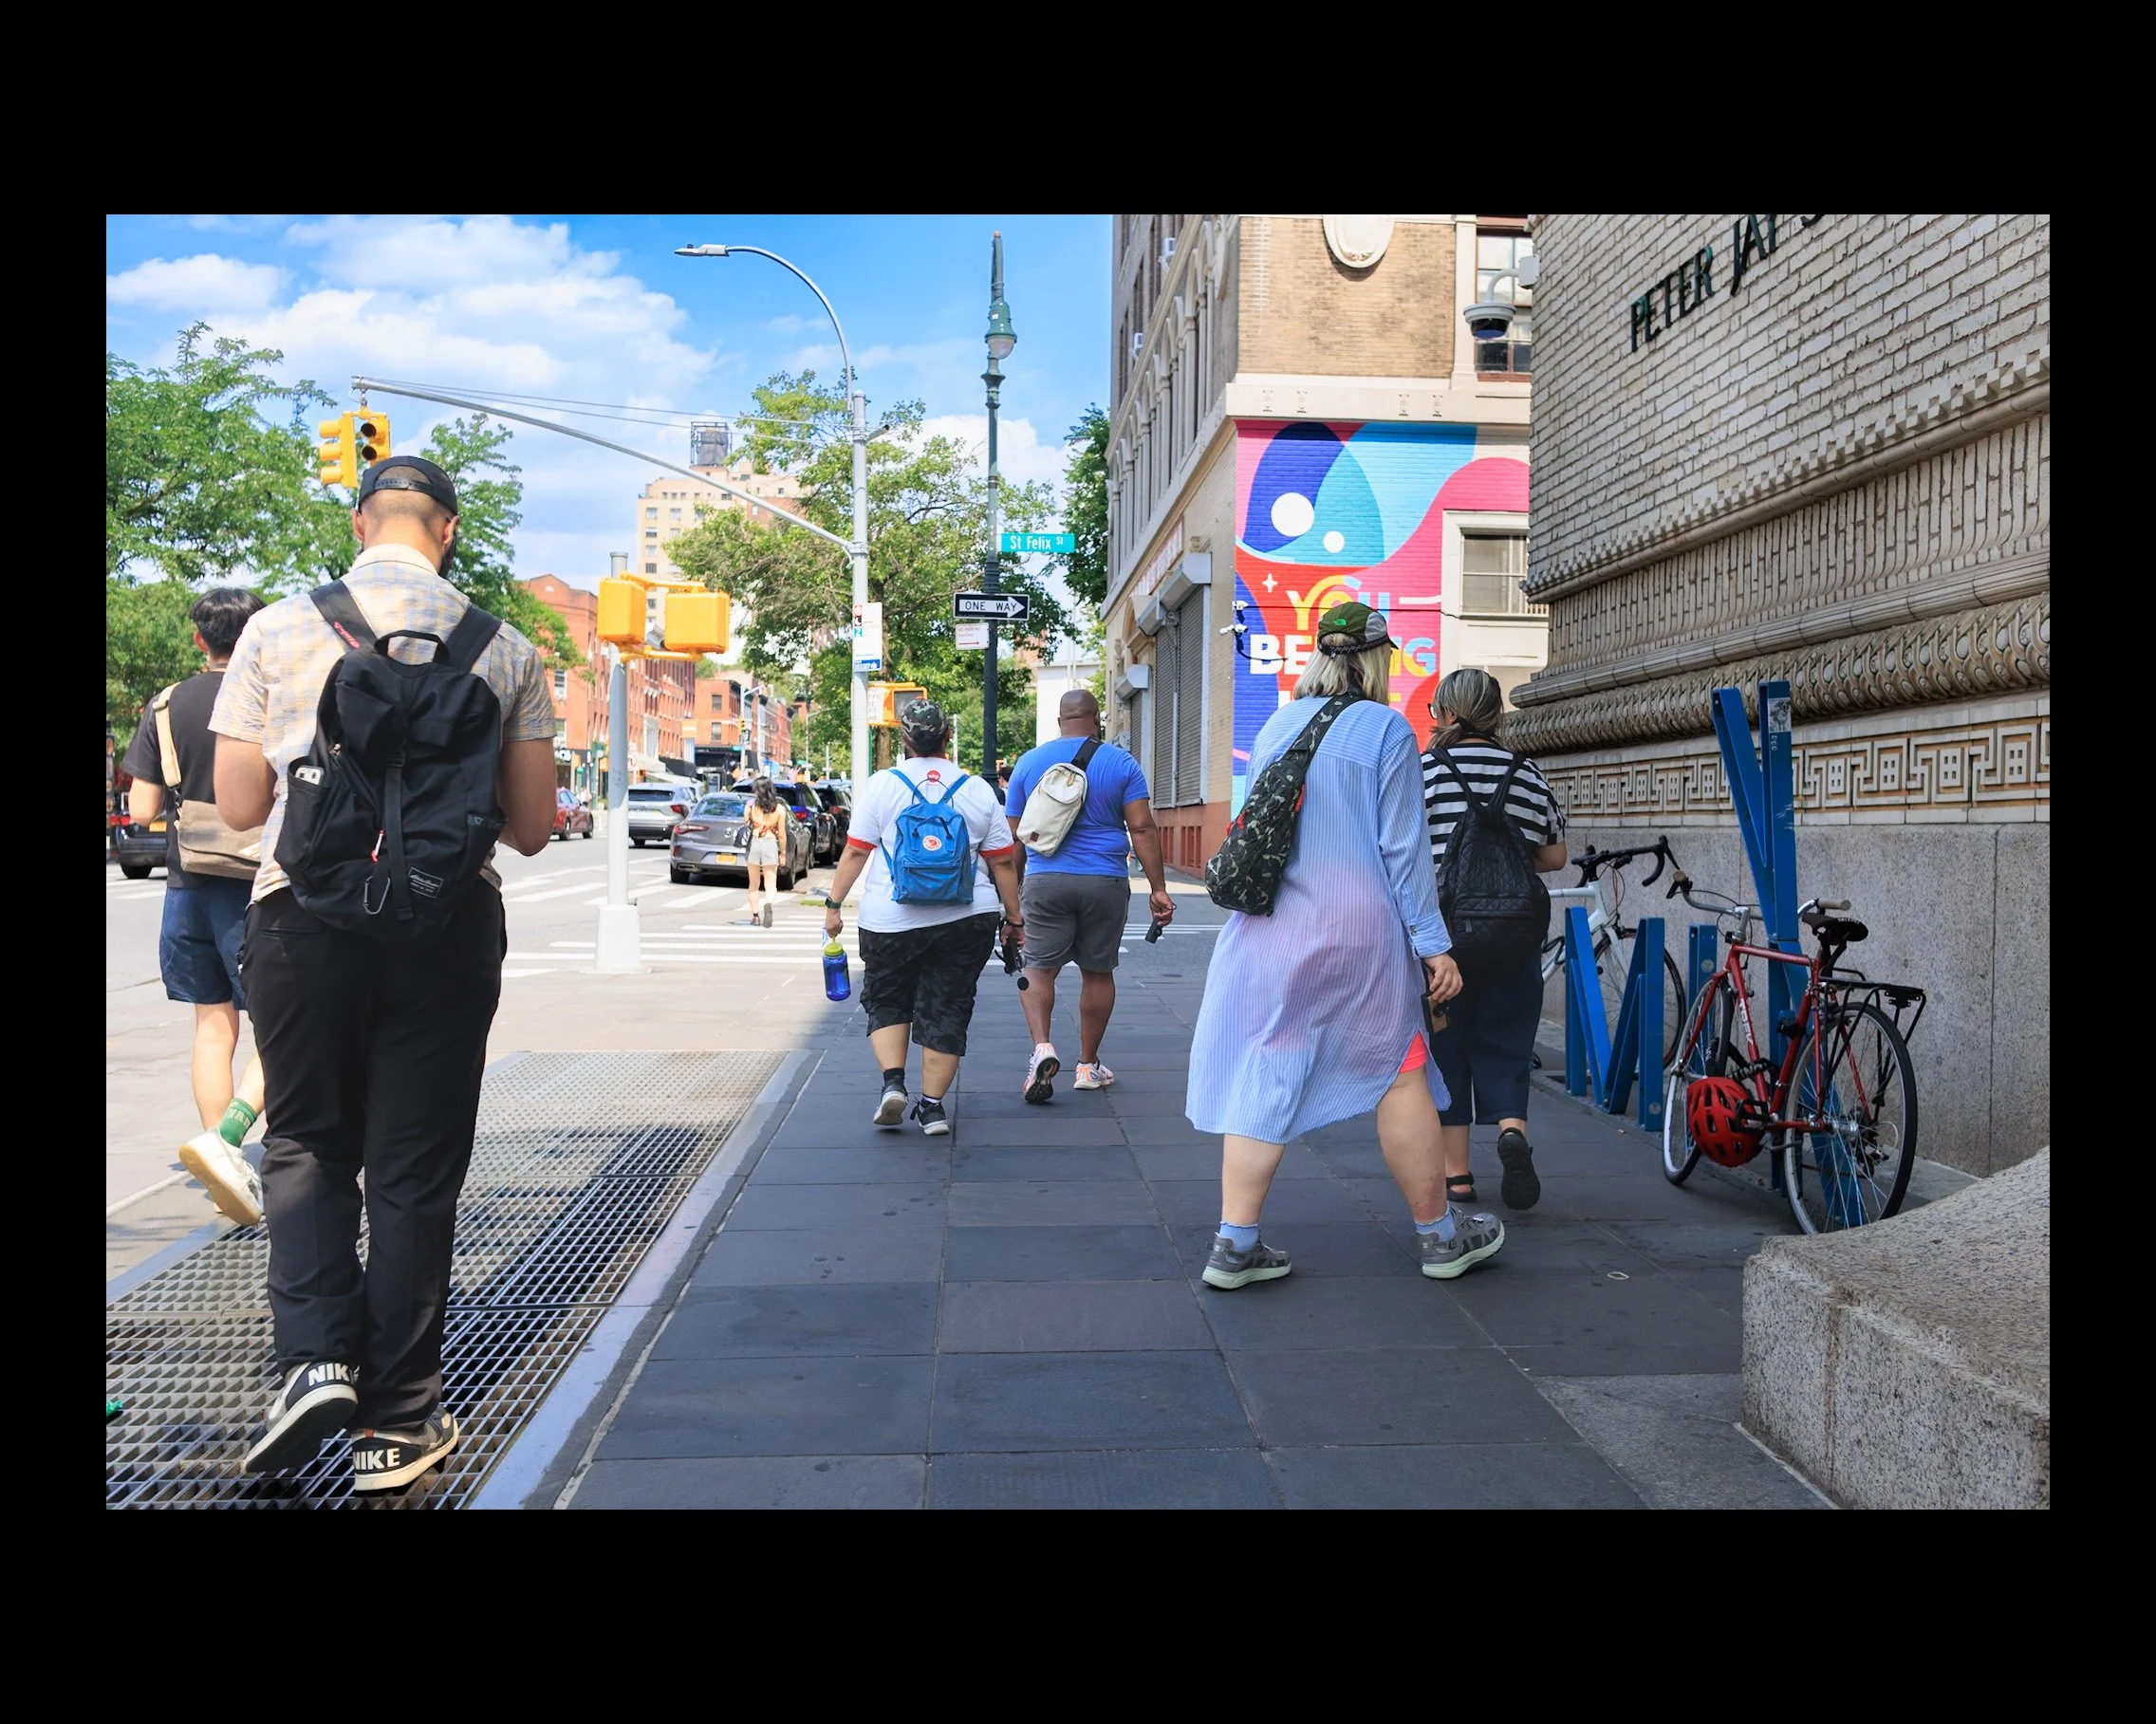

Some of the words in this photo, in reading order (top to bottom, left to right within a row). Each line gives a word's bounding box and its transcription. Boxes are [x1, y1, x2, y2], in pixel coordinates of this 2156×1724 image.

[1630, 244, 1715, 353] PETER
[1010, 535, 1022, 550] St
[1027, 536, 1051, 550] Felix
[1056, 536, 1064, 546] St
[965, 601, 986, 611] ONE
[995, 602, 1017, 612] WAY
[353, 1447, 400, 1471] NIKE
